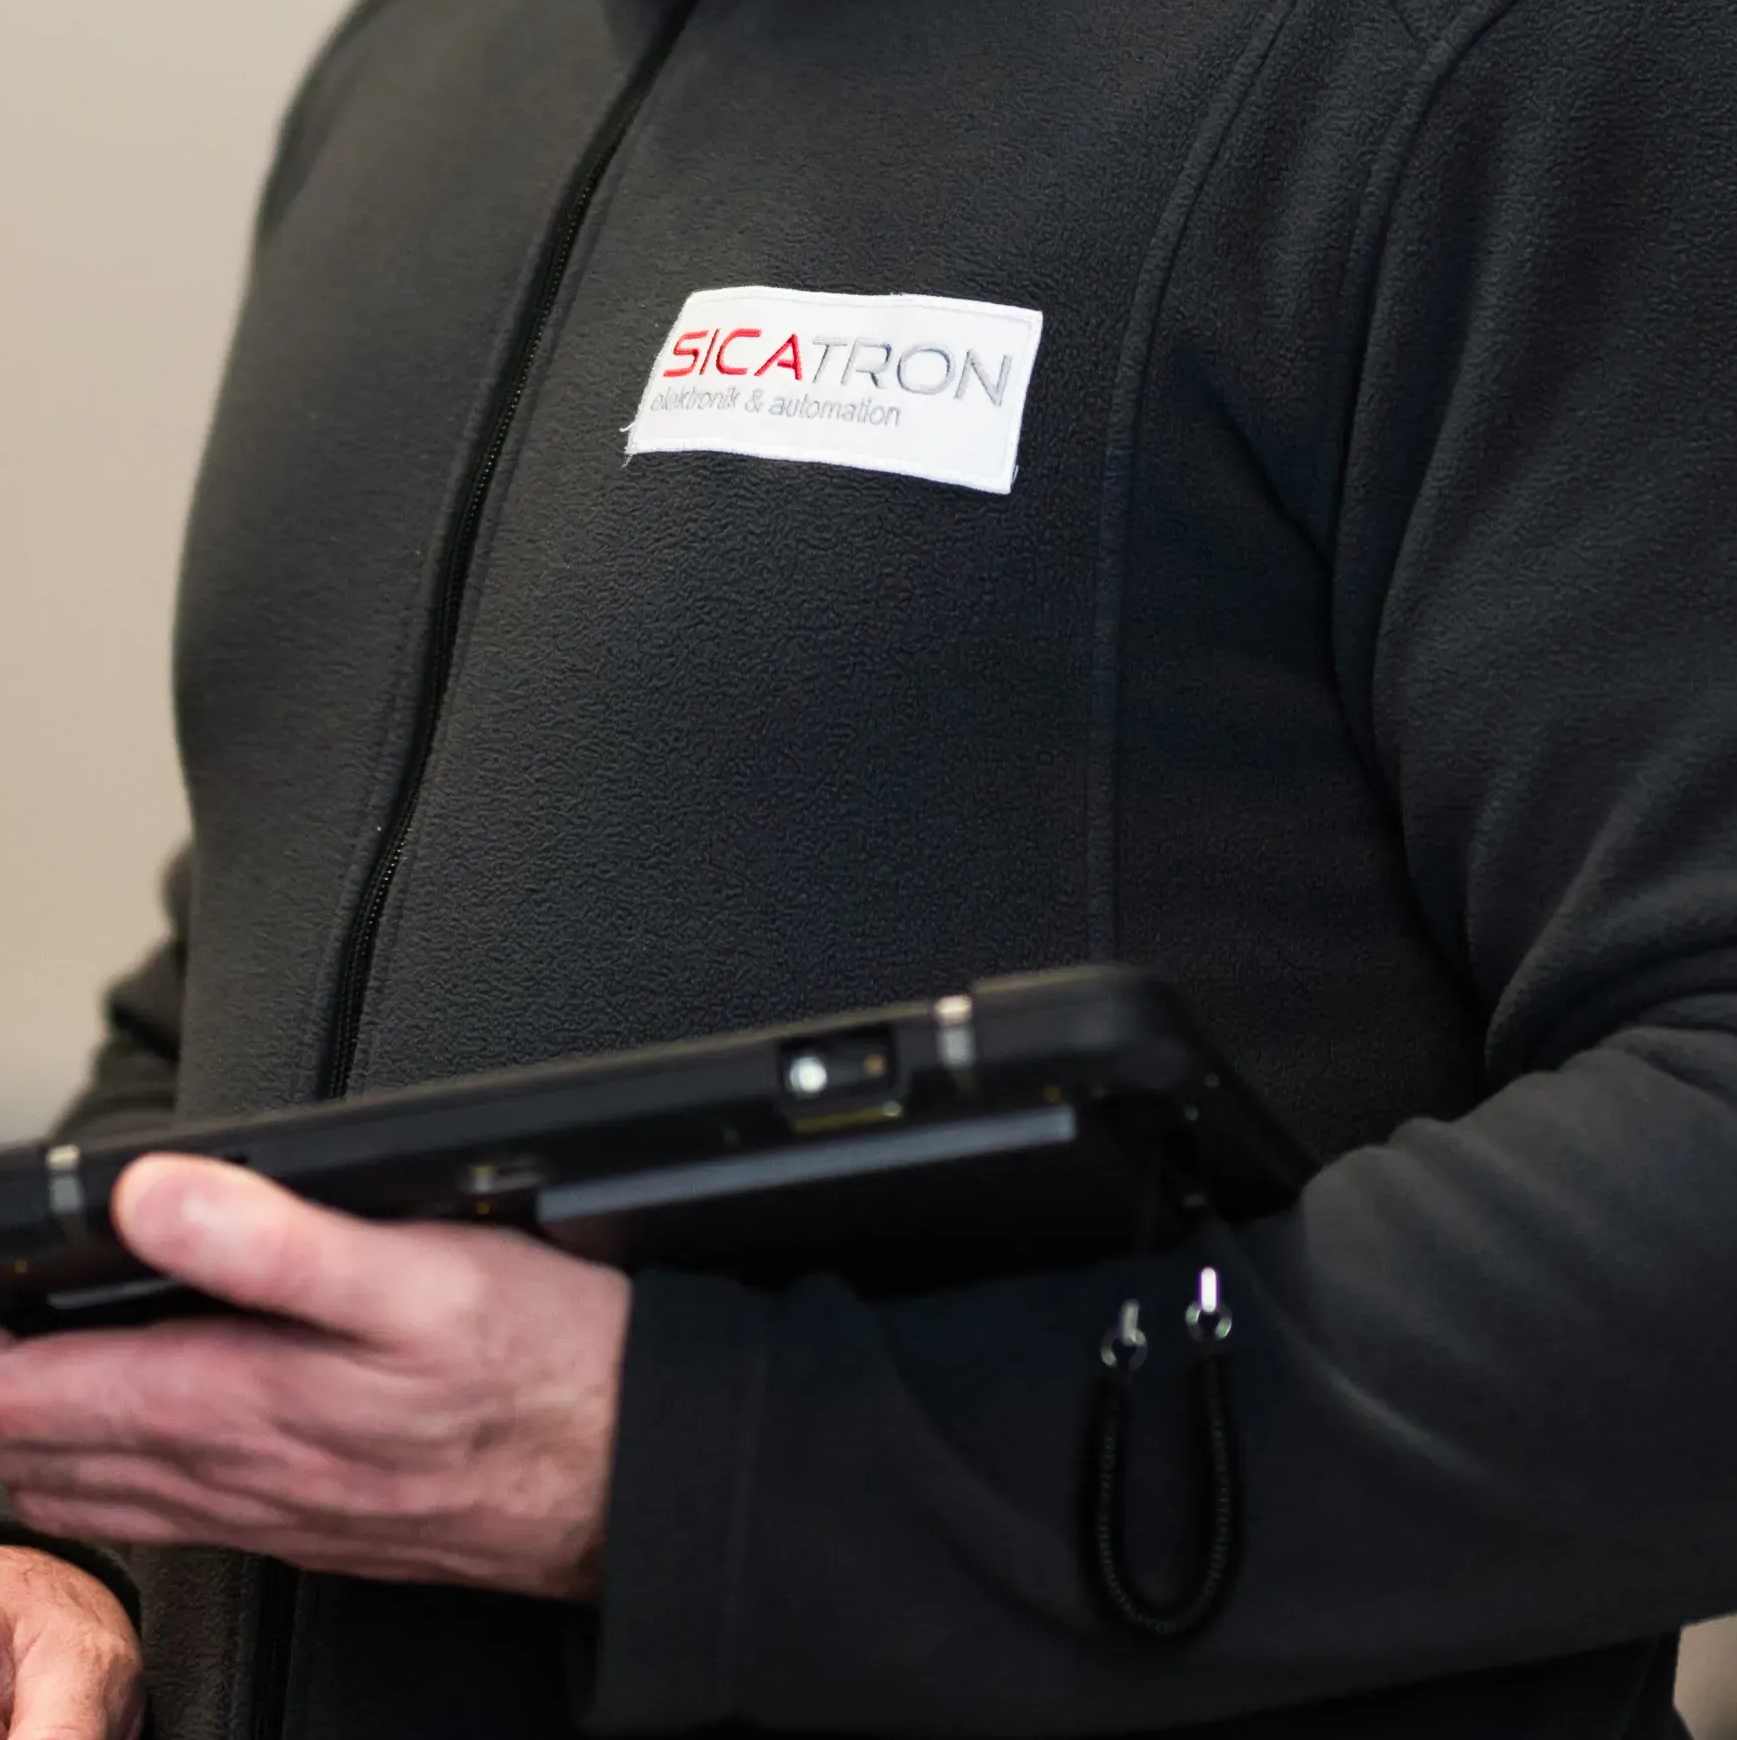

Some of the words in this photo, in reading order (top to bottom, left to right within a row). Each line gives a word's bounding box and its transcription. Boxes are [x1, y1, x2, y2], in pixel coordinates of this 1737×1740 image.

[663, 327, 1012, 407] SICATRON
[649, 385, 740, 413] elektronik
[743, 388, 765, 414] &
[768, 393, 903, 428] automation
